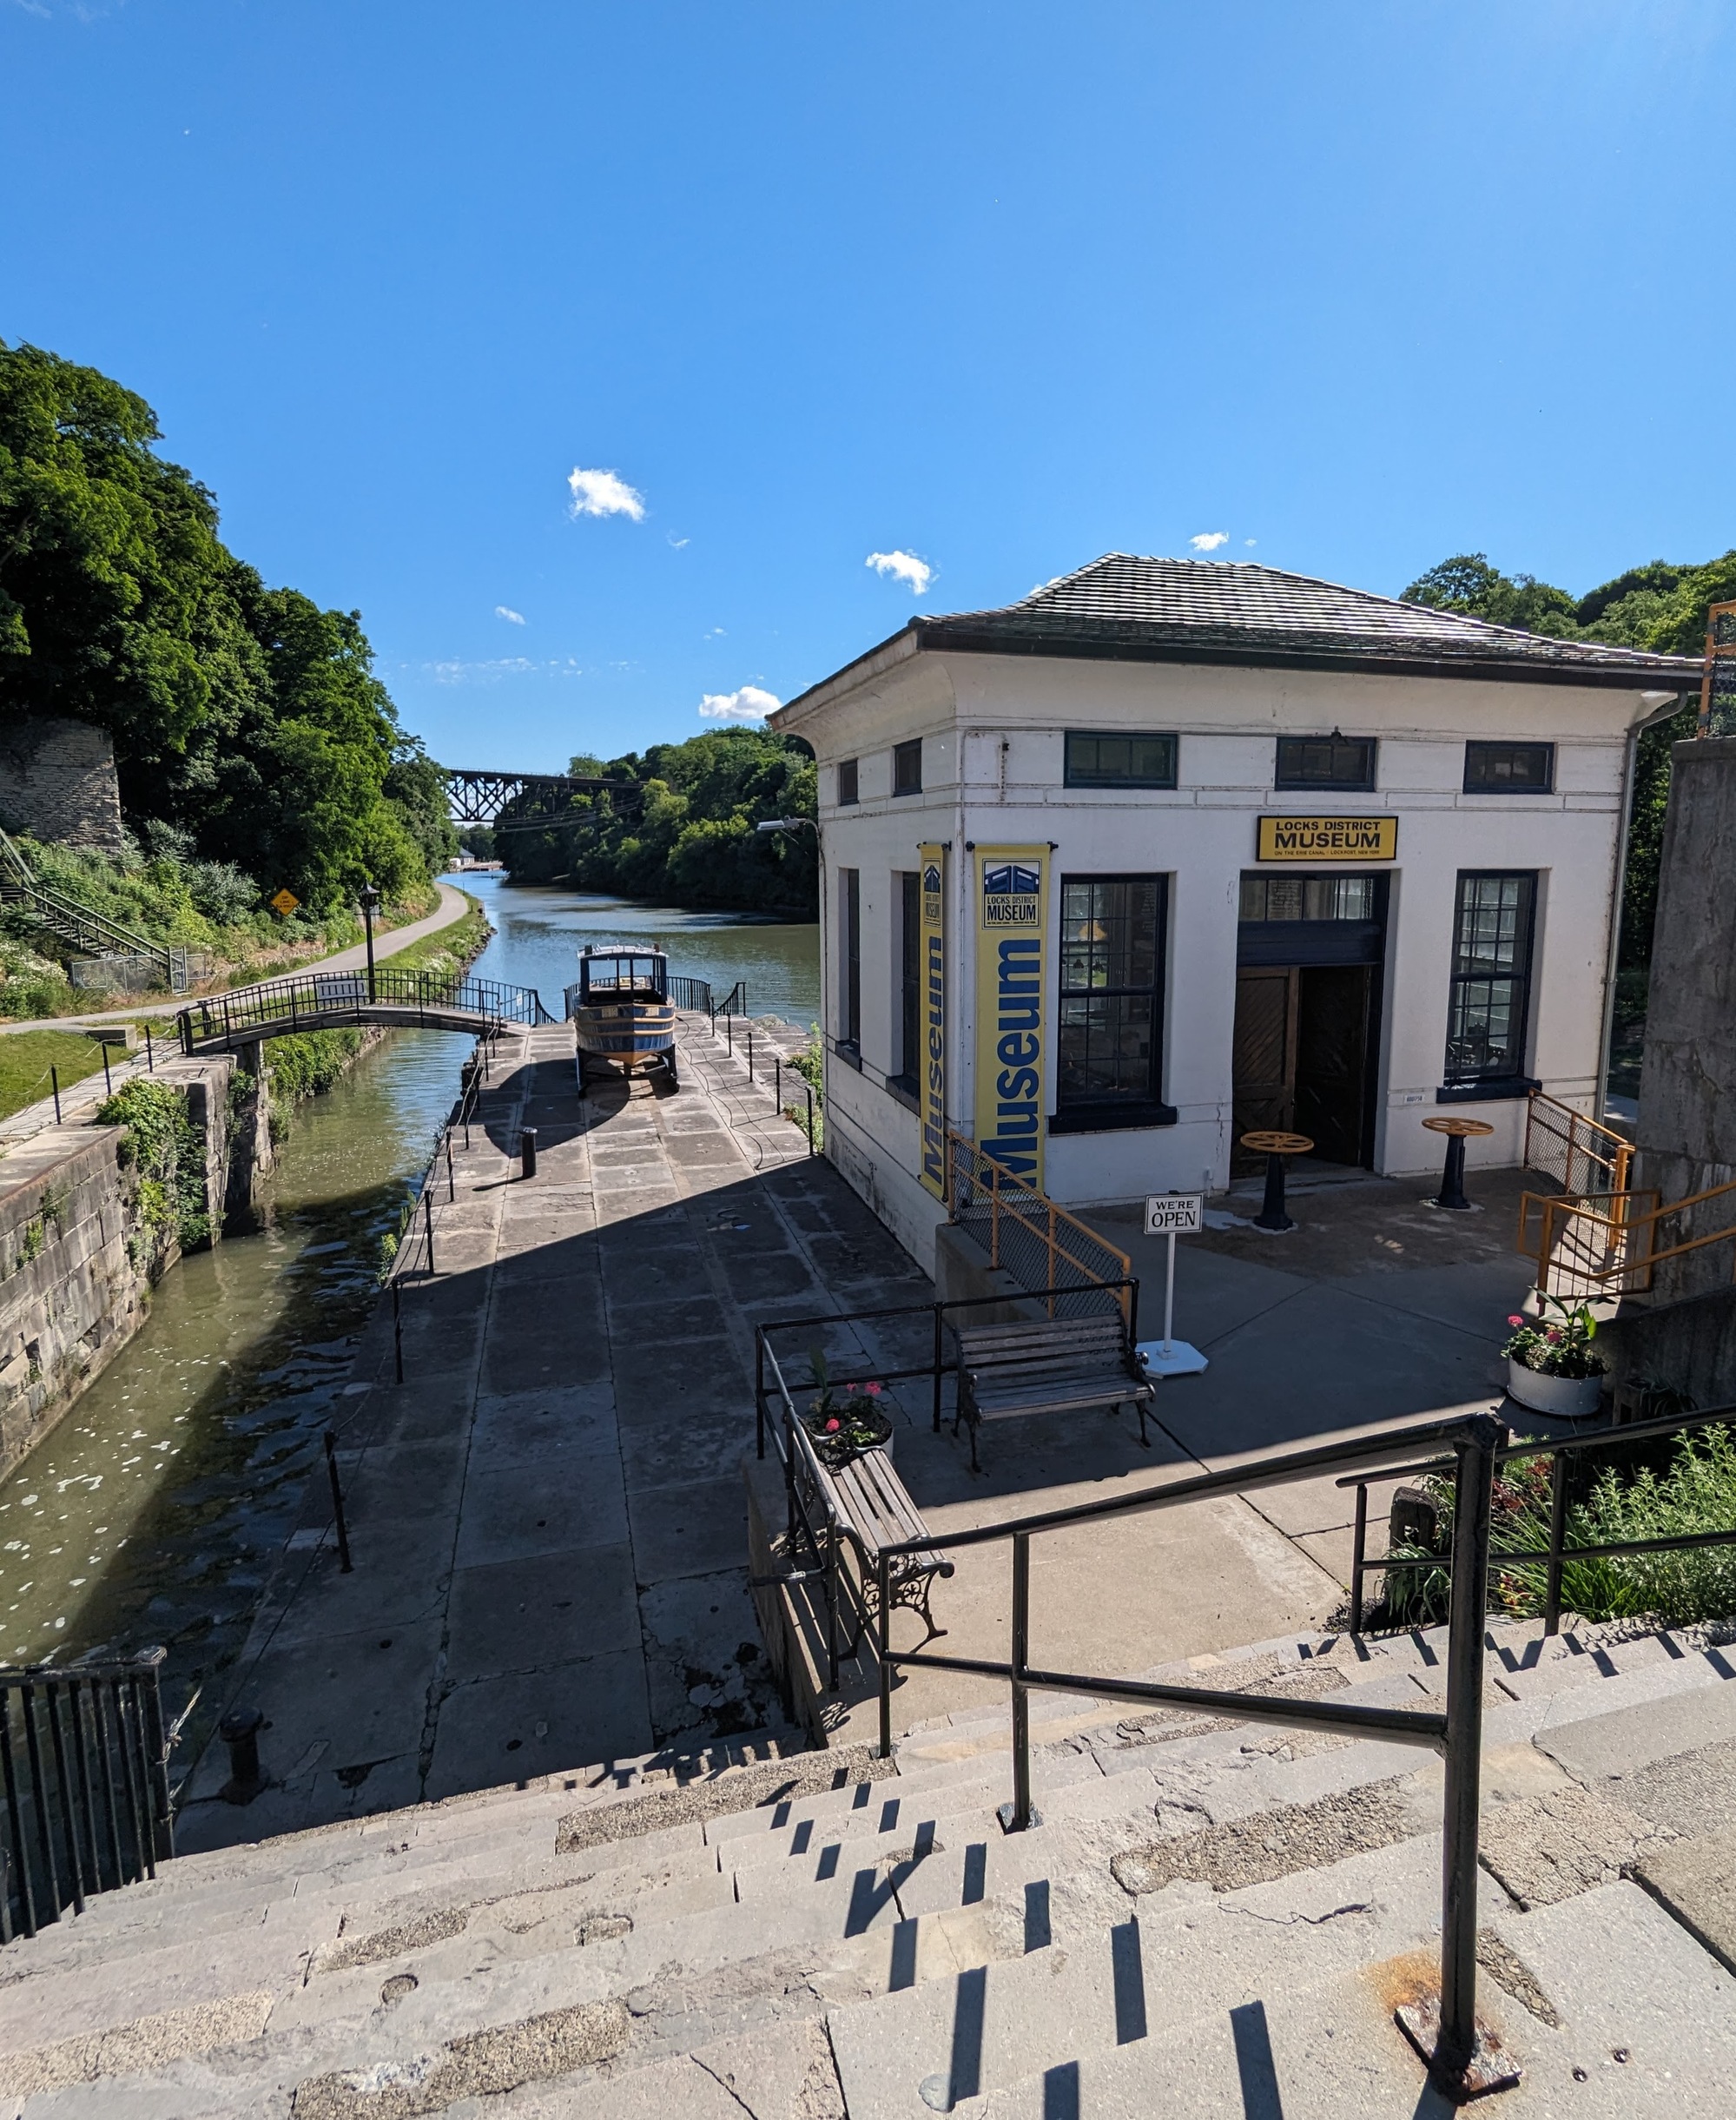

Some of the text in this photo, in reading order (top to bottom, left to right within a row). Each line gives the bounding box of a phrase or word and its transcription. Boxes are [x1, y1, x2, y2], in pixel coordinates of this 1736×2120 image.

[1276, 821, 1381, 831] LOCKS DISTRICT
[1275, 832, 1381, 849] MUSEUM
[1012, 895, 1036, 904] DISTRICT
[987, 904, 1036, 921] MUSEUM
[924, 935, 943, 1186] Museum
[980, 939, 1040, 1191] Museum
[1156, 1200, 1194, 1210] WE'RE
[1152, 1211, 1196, 1227] OPEN
